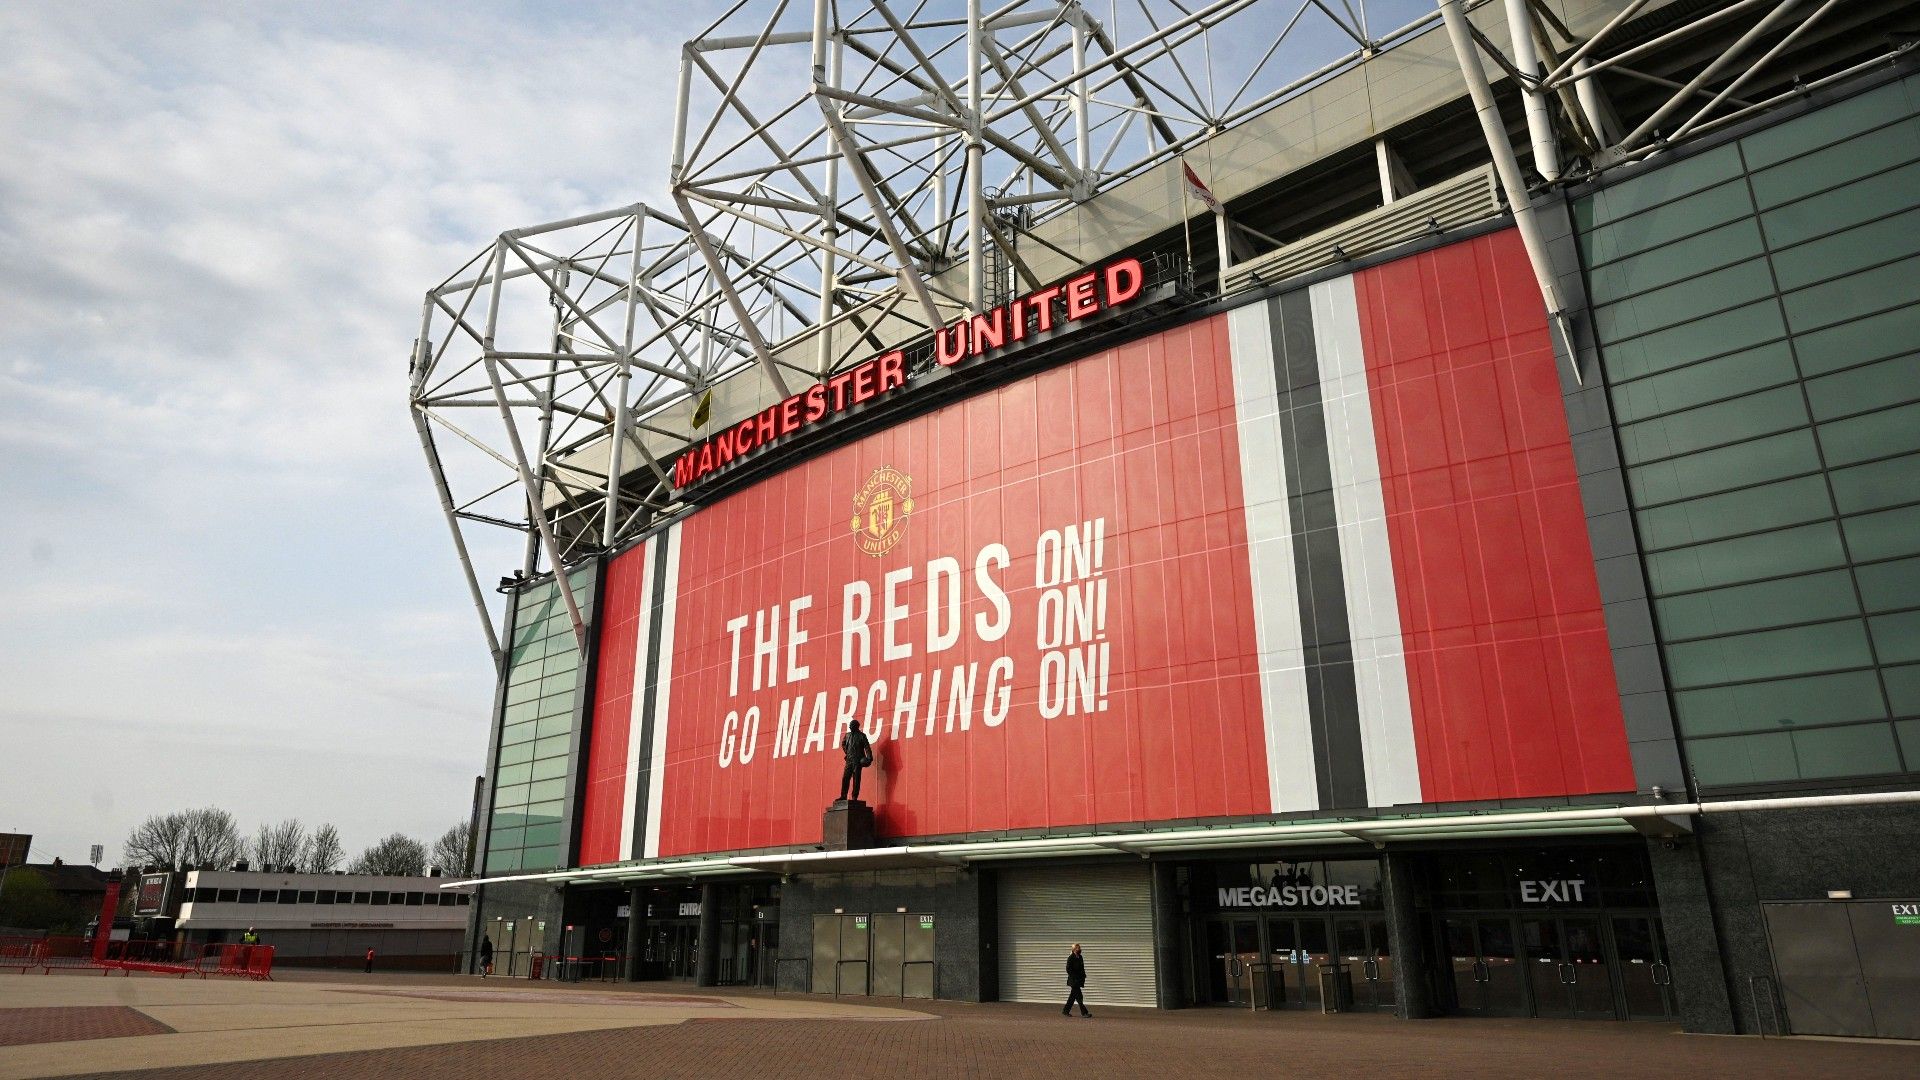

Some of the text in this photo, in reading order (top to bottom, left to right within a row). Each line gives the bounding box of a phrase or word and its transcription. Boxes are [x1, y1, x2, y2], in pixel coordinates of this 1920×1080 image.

[674, 257, 1145, 490] MANCHESTER UNITED
[856, 472, 908, 508] MANCHESTER
[863, 530, 900, 552] UNITED
[1035, 517, 1105, 589] ON!
[726, 543, 1012, 698] THE REDS
[1037, 578, 1108, 650] ON!
[718, 656, 1014, 769] GO MARCHING
[1038, 641, 1110, 719] ON!
[1218, 884, 1361, 907] MEGASTORE
[1519, 879, 1585, 903] EXIT
